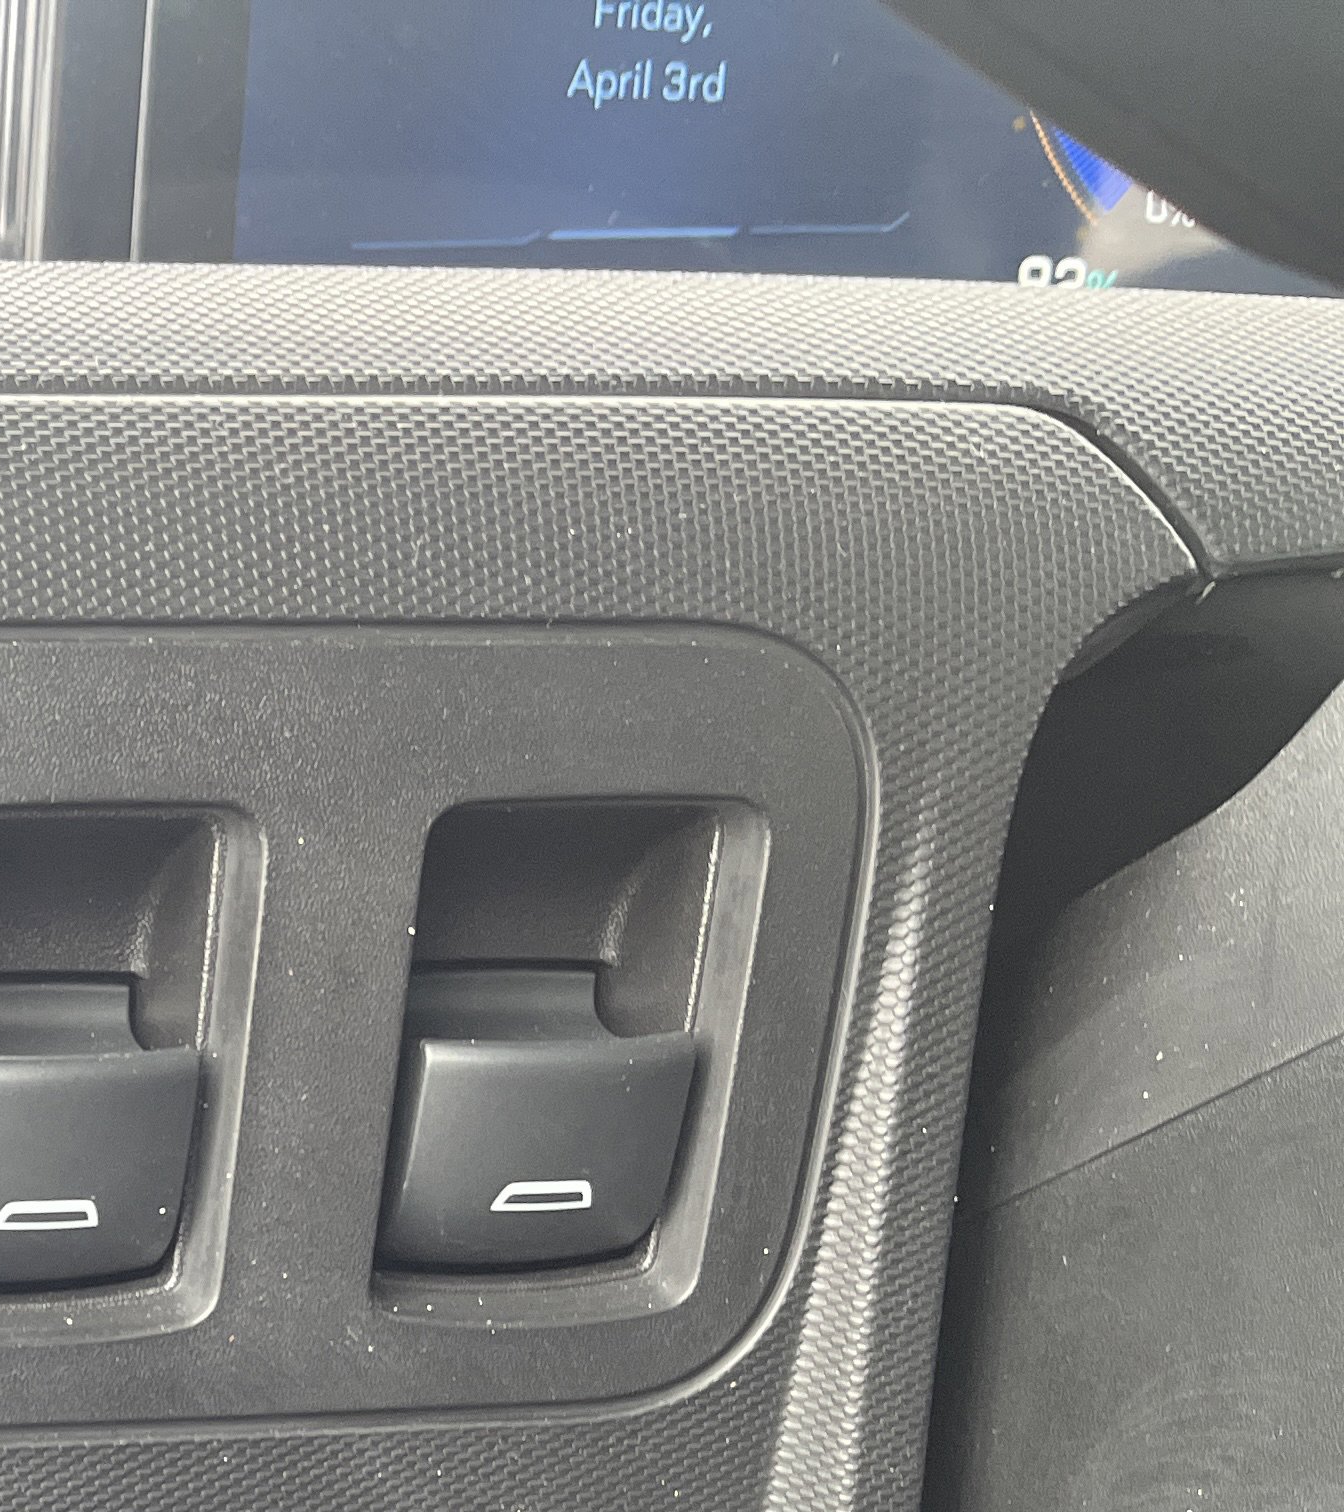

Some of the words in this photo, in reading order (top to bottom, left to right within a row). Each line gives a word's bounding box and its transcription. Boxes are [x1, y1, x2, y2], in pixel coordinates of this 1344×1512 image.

[594, 0, 713, 43] Friday,
[566, 57, 653, 109] April
[662, 59, 727, 102] 3rd
